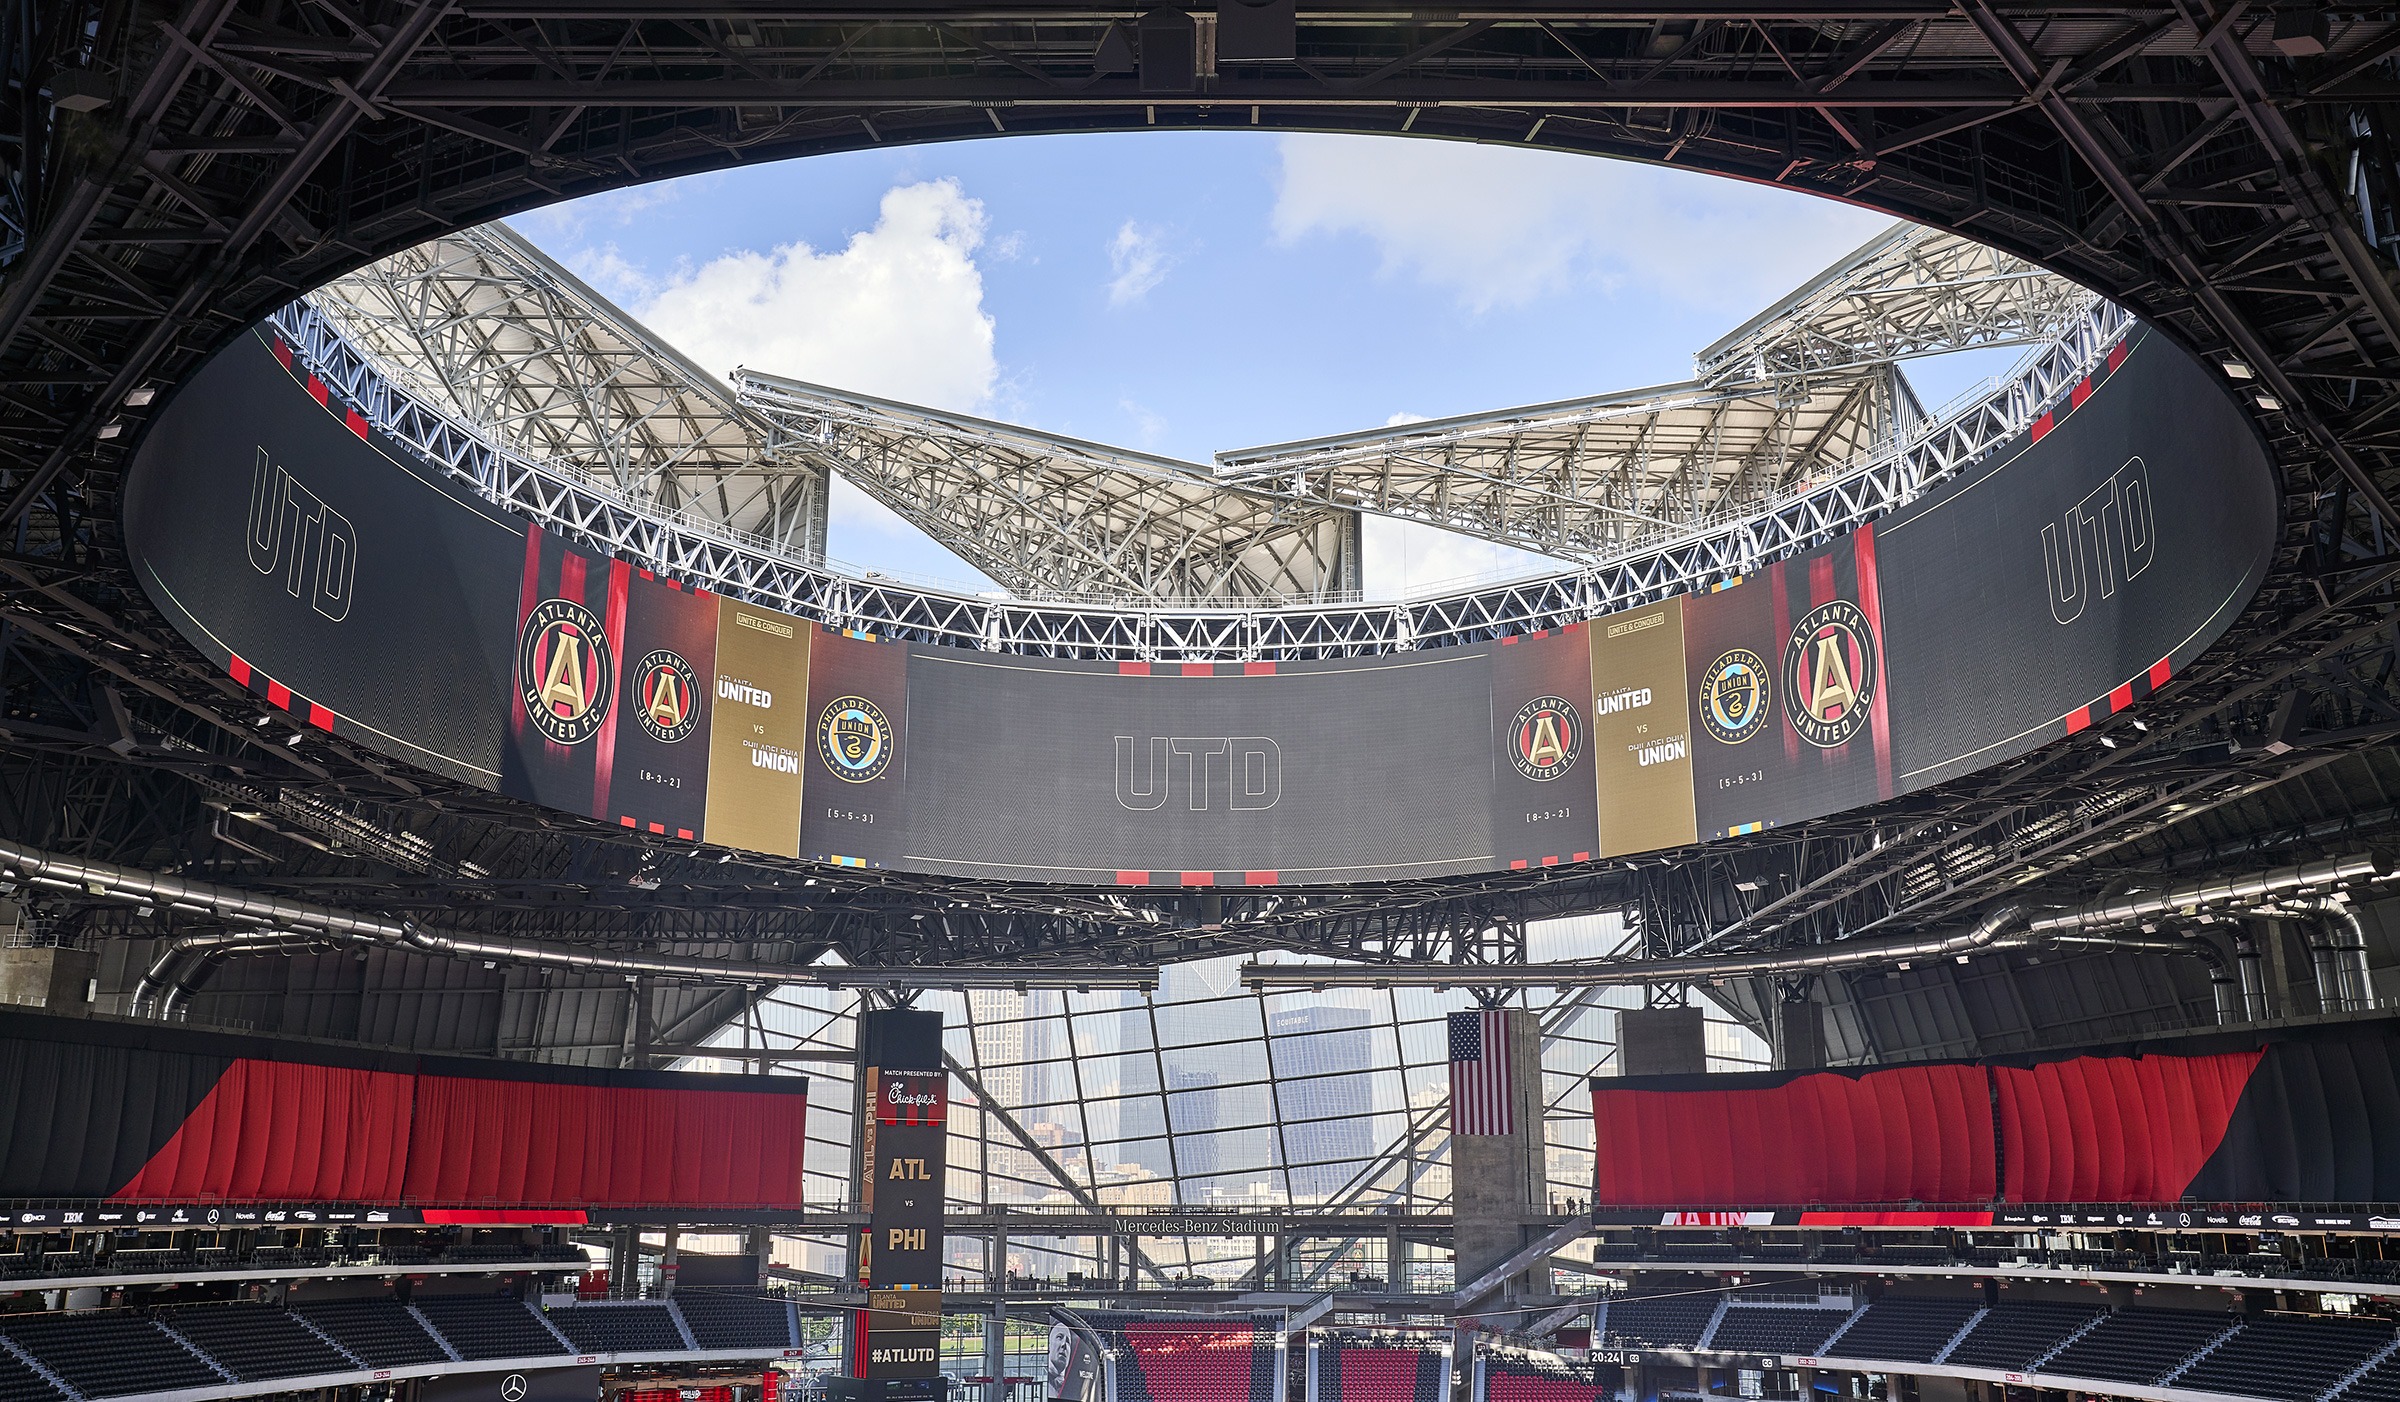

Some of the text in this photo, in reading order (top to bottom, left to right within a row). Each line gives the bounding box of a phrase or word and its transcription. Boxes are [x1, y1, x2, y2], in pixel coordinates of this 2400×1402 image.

[247, 445, 357, 622] UTD
[2041, 455, 2155, 625] UTD
[537, 604, 603, 648] ATLANTA
[738, 615, 791, 636] UNITE & CONQUER
[1609, 615, 1662, 636] UNITE & CONQUER
[1794, 605, 1859, 650] ATLANTA
[644, 653, 693, 682] ATLANTA
[1702, 653, 1766, 701] PHILADELPHIA
[718, 679, 772, 709] UNITED
[1721, 676, 1748, 692] UNION
[526, 688, 600, 739] UNITED FC
[1518, 699, 1570, 724] ATLANTA
[1597, 687, 1652, 716] UNITED
[639, 708, 692, 739] UNITED FC
[821, 699, 890, 741] PHILADELPHIA
[841, 721, 869, 734] UNION
[1796, 690, 1871, 742] UNITED FC
[753, 724, 765, 735] VS
[1636, 724, 1648, 734] VS
[751, 748, 799, 775] UNION
[1517, 751, 1575, 778] UNITED FC
[1638, 740, 1686, 767] UNION
[1114, 735, 1282, 811] UTD
[1276, 1015, 1309, 1027] EQUITABLE
[888, 1082, 938, 1107] Chick-fil-A
[865, 1091, 877, 1126] PHI
[863, 1144, 874, 1184] ATL
[889, 1158, 932, 1180] ATL
[63, 1212, 84, 1223] IBM
[235, 1212, 256, 1220] Novelis
[1114, 1219, 1280, 1233] Mercedes-Benz Stadium
[2206, 1216, 2228, 1224] Novelis
[888, 1228, 926, 1250] PHI
[872, 1299, 906, 1309] UNITED
[911, 1315, 940, 1326] UNION
[871, 1348, 935, 1363] #ATLUTD
[1591, 1351, 1620, 1363] 20:24
